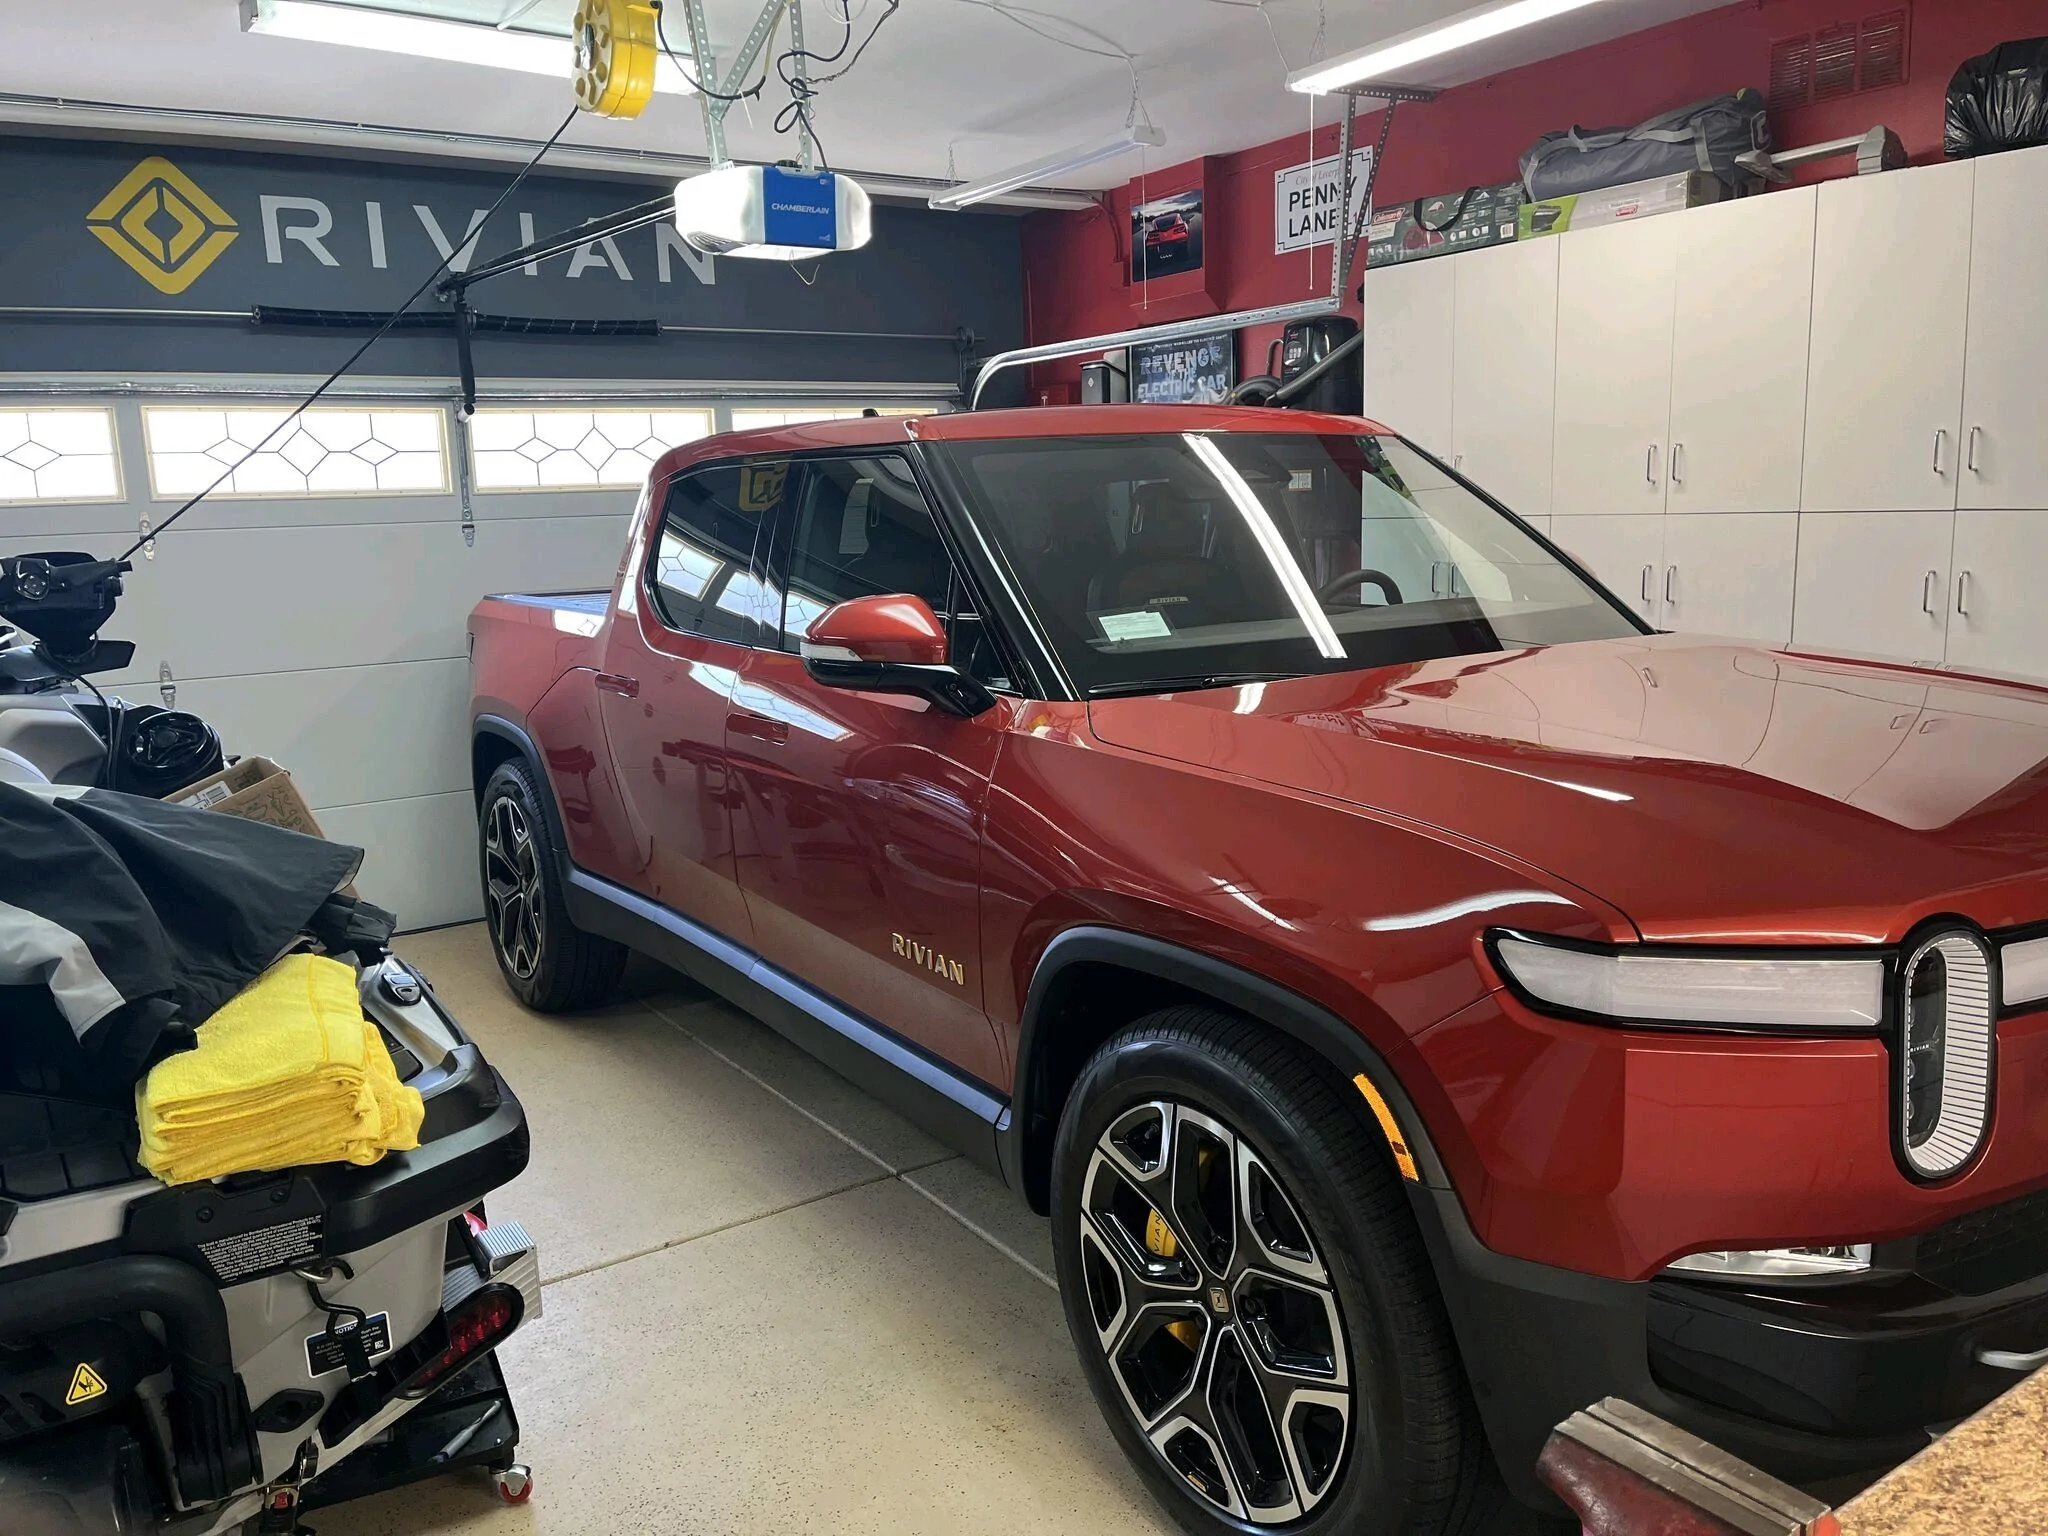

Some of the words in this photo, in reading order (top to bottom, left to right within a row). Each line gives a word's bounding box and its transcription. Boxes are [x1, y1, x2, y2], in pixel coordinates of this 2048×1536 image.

[771, 202, 830, 215] CHAMBERLAIN
[1288, 208, 1338, 238] LANE
[259, 194, 716, 285] RIVIAN
[1140, 346, 1222, 375] REVENGE
[1137, 376, 1195, 400] ELECTRIC
[1197, 374, 1228, 392] CAR
[891, 932, 964, 986] RIVIAN
